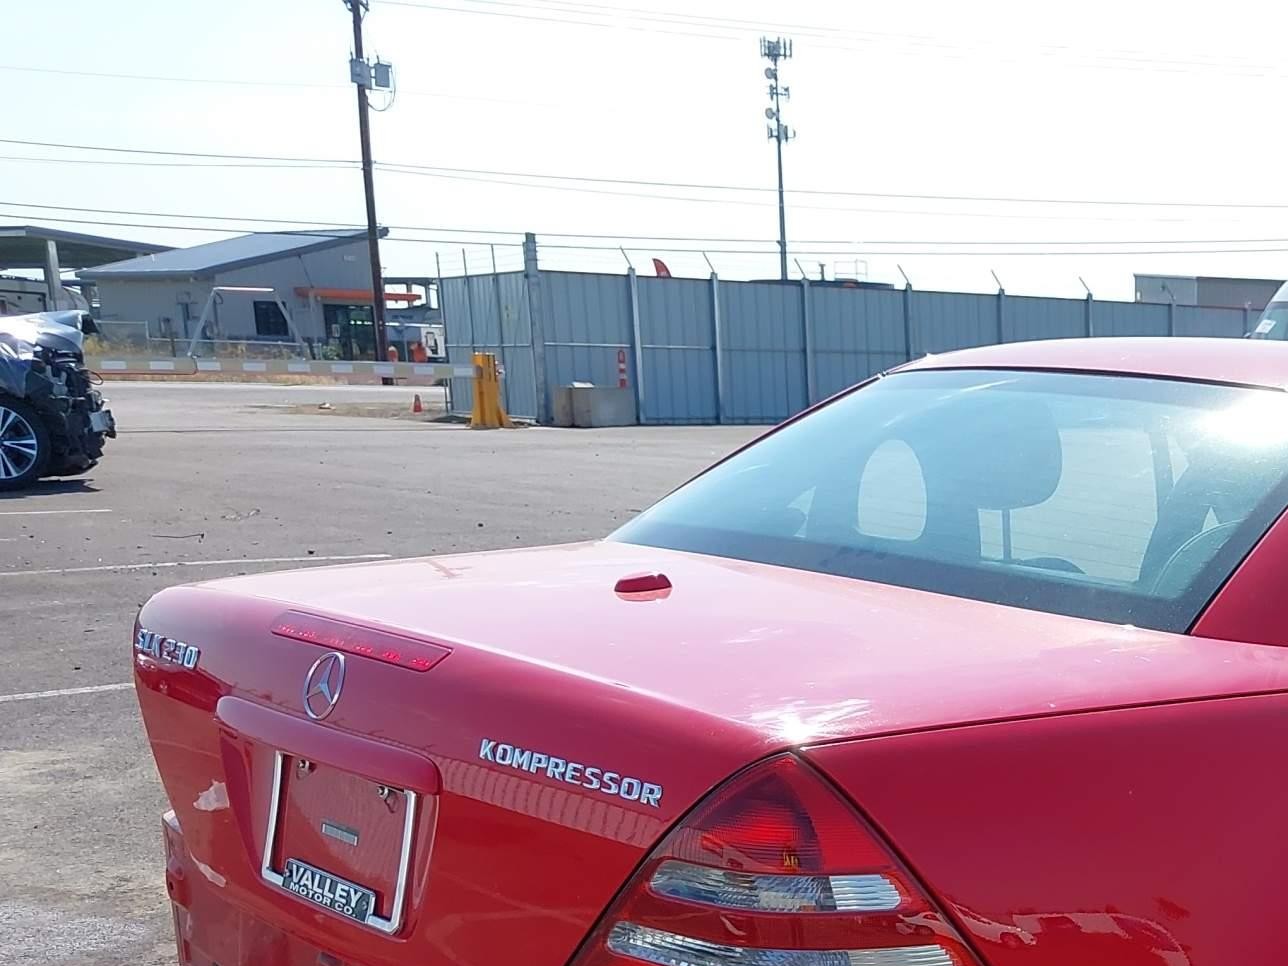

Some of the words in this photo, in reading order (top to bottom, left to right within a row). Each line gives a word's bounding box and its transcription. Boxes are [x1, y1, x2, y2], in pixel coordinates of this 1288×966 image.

[162, 638, 199, 668] 230
[479, 738, 663, 807] KOMPRESSOR
[289, 882, 331, 906] MOTOR
[334, 902, 356, 918] CO.
[292, 863, 362, 908] VALLEY
